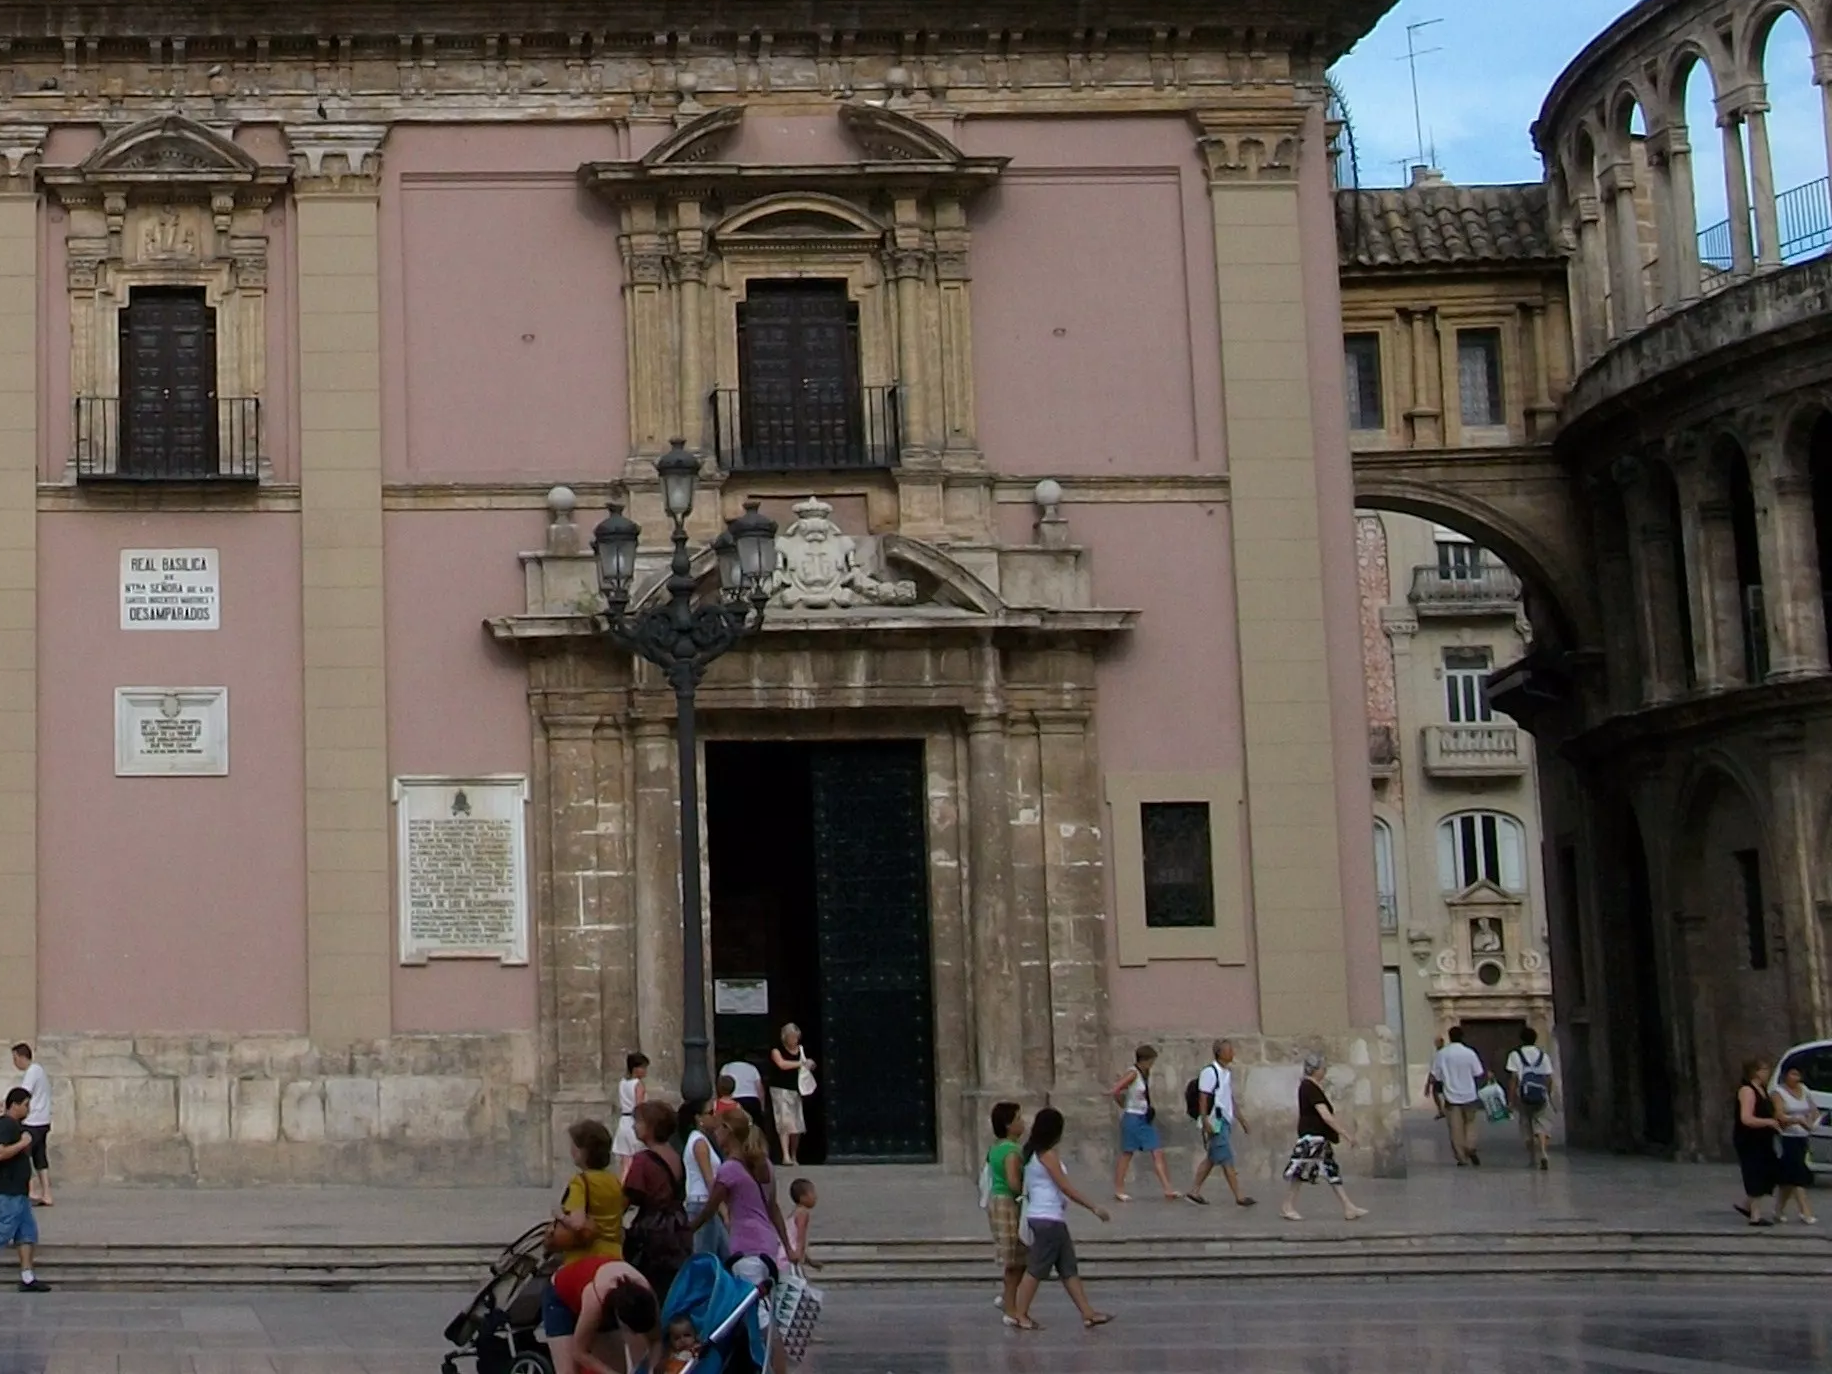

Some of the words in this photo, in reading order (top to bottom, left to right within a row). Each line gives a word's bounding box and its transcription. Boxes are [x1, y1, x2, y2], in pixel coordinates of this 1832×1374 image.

[131, 558, 156, 571] REAL
[162, 558, 207, 571] BASILICA
[150, 581, 183, 593] SEÑORA
[129, 607, 210, 621] DESAMPARADOS
